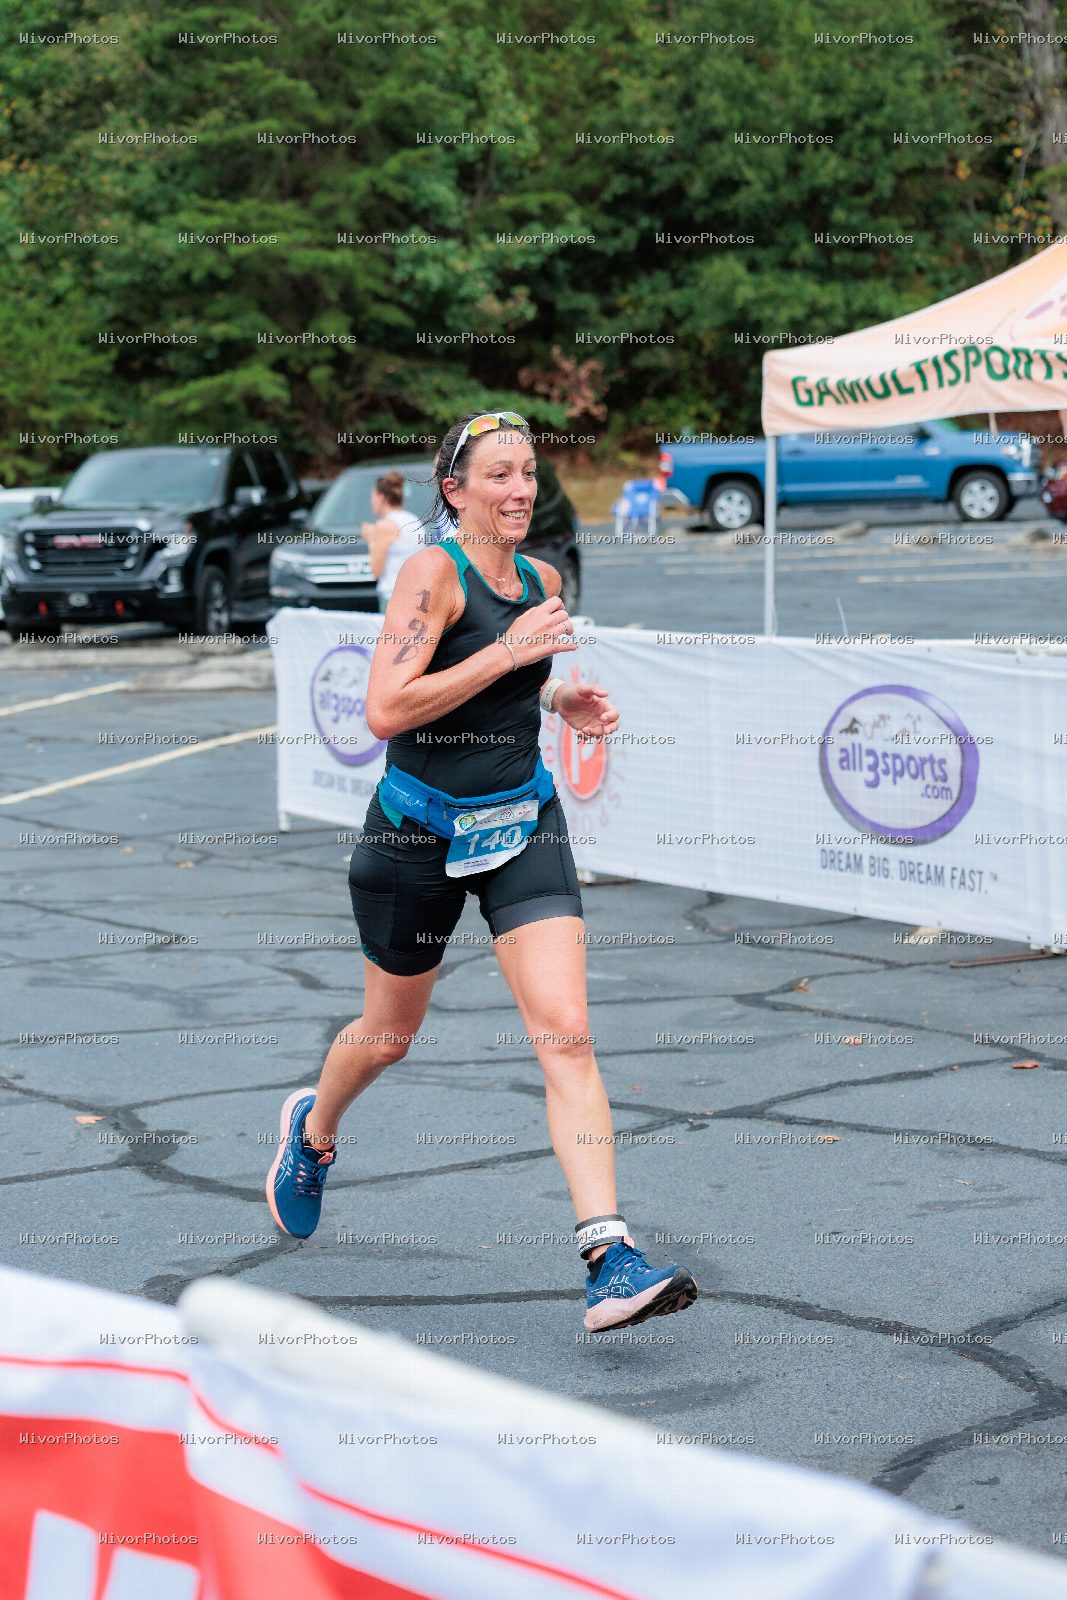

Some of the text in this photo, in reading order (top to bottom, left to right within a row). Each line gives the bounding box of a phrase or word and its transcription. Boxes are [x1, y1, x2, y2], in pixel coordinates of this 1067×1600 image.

[838, 742, 949, 789] all3sports
[921, 783, 953, 801] .com
[467, 825, 522, 856] 140
[820, 848, 864, 875] DREAM
[868, 855, 895, 880] BIG.
[899, 859, 946, 887] DREAM
